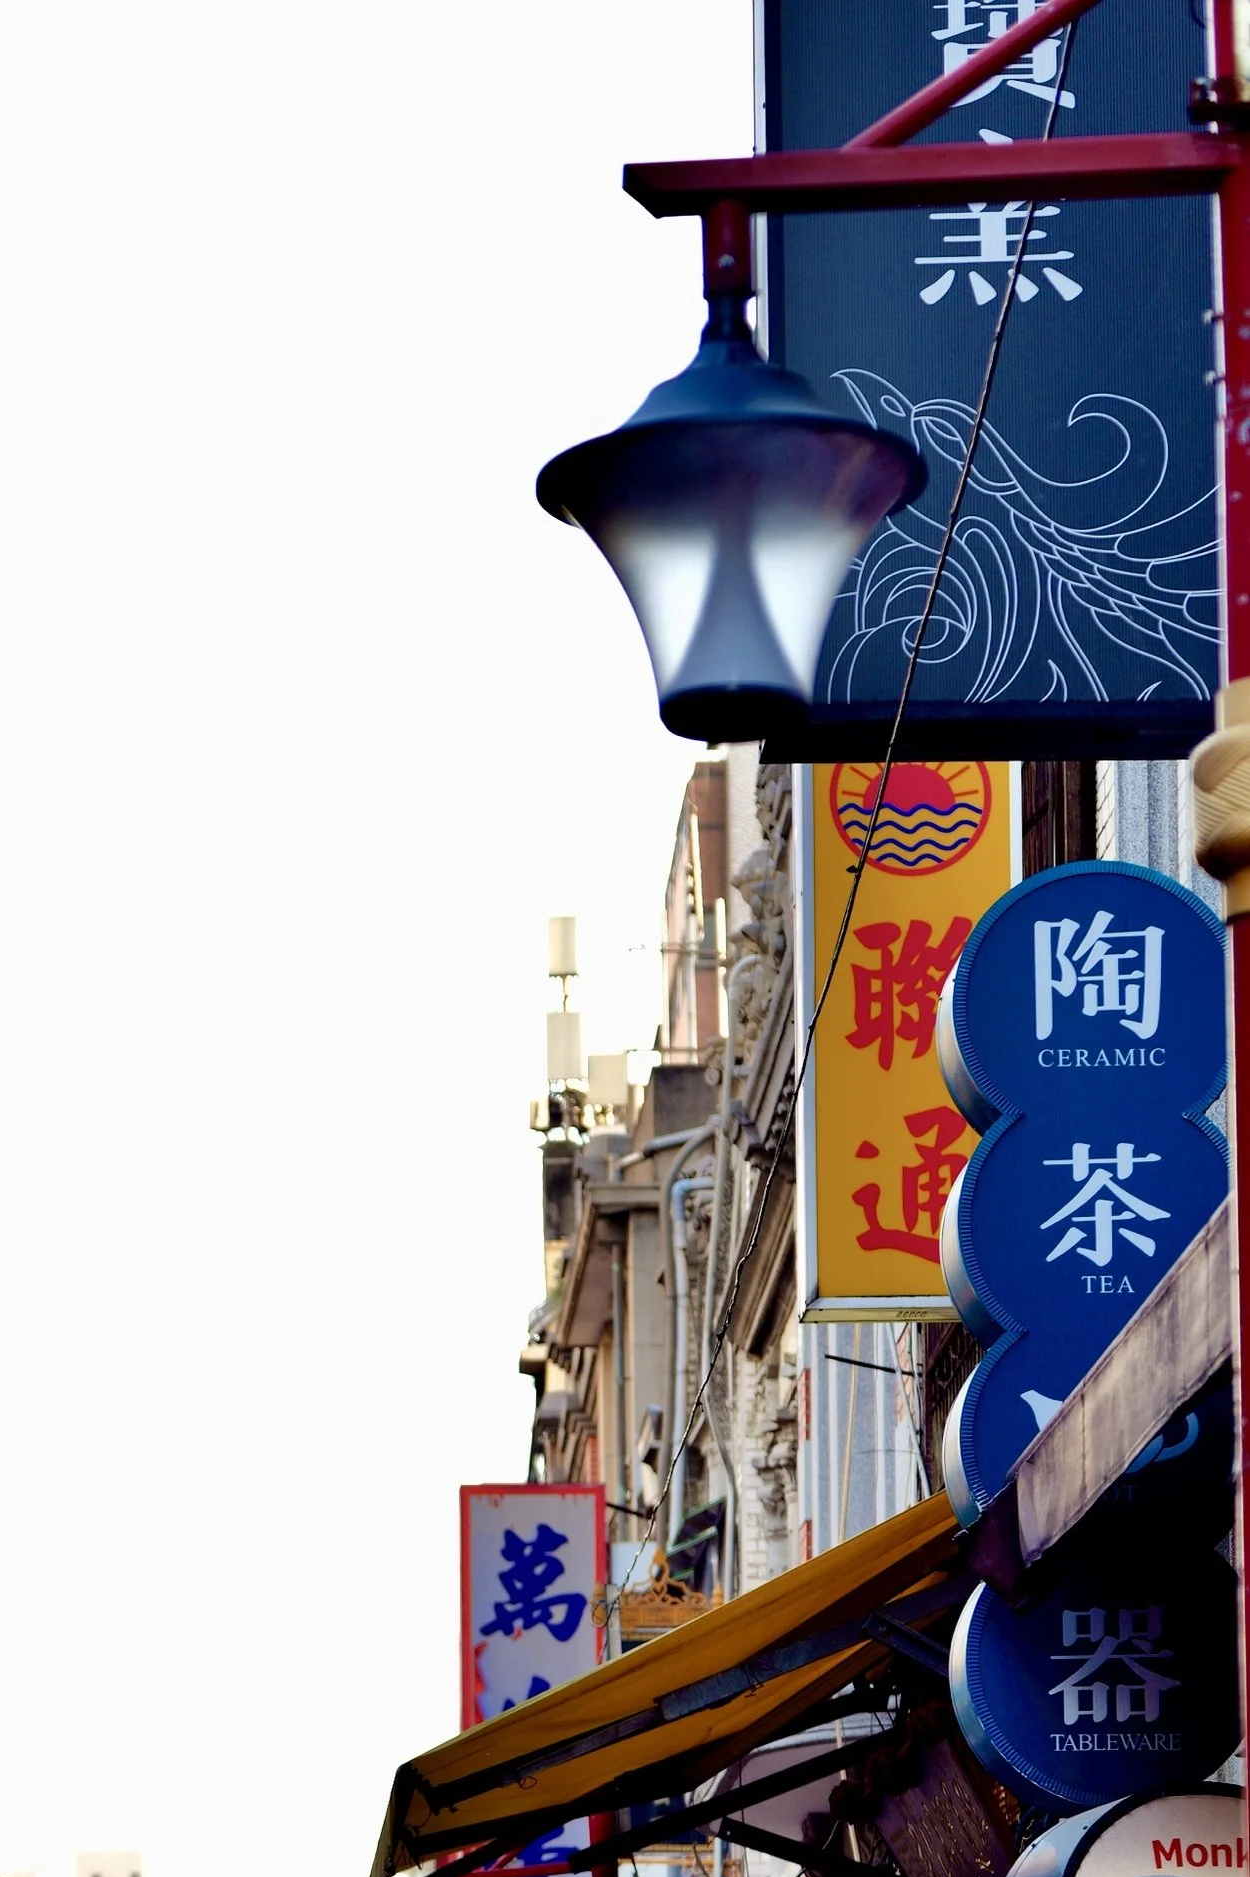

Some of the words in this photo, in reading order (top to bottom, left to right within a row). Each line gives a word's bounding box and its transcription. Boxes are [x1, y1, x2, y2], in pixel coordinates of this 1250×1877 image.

[1033, 910, 1166, 1040] 陶
[1037, 1048, 1167, 1068] CERAMIC
[1040, 1142, 1171, 1267] 茶
[1081, 1275, 1136, 1294] TEA
[1048, 1606, 1182, 1725] 器
[1050, 1732, 1181, 1753] TABLEWARE
